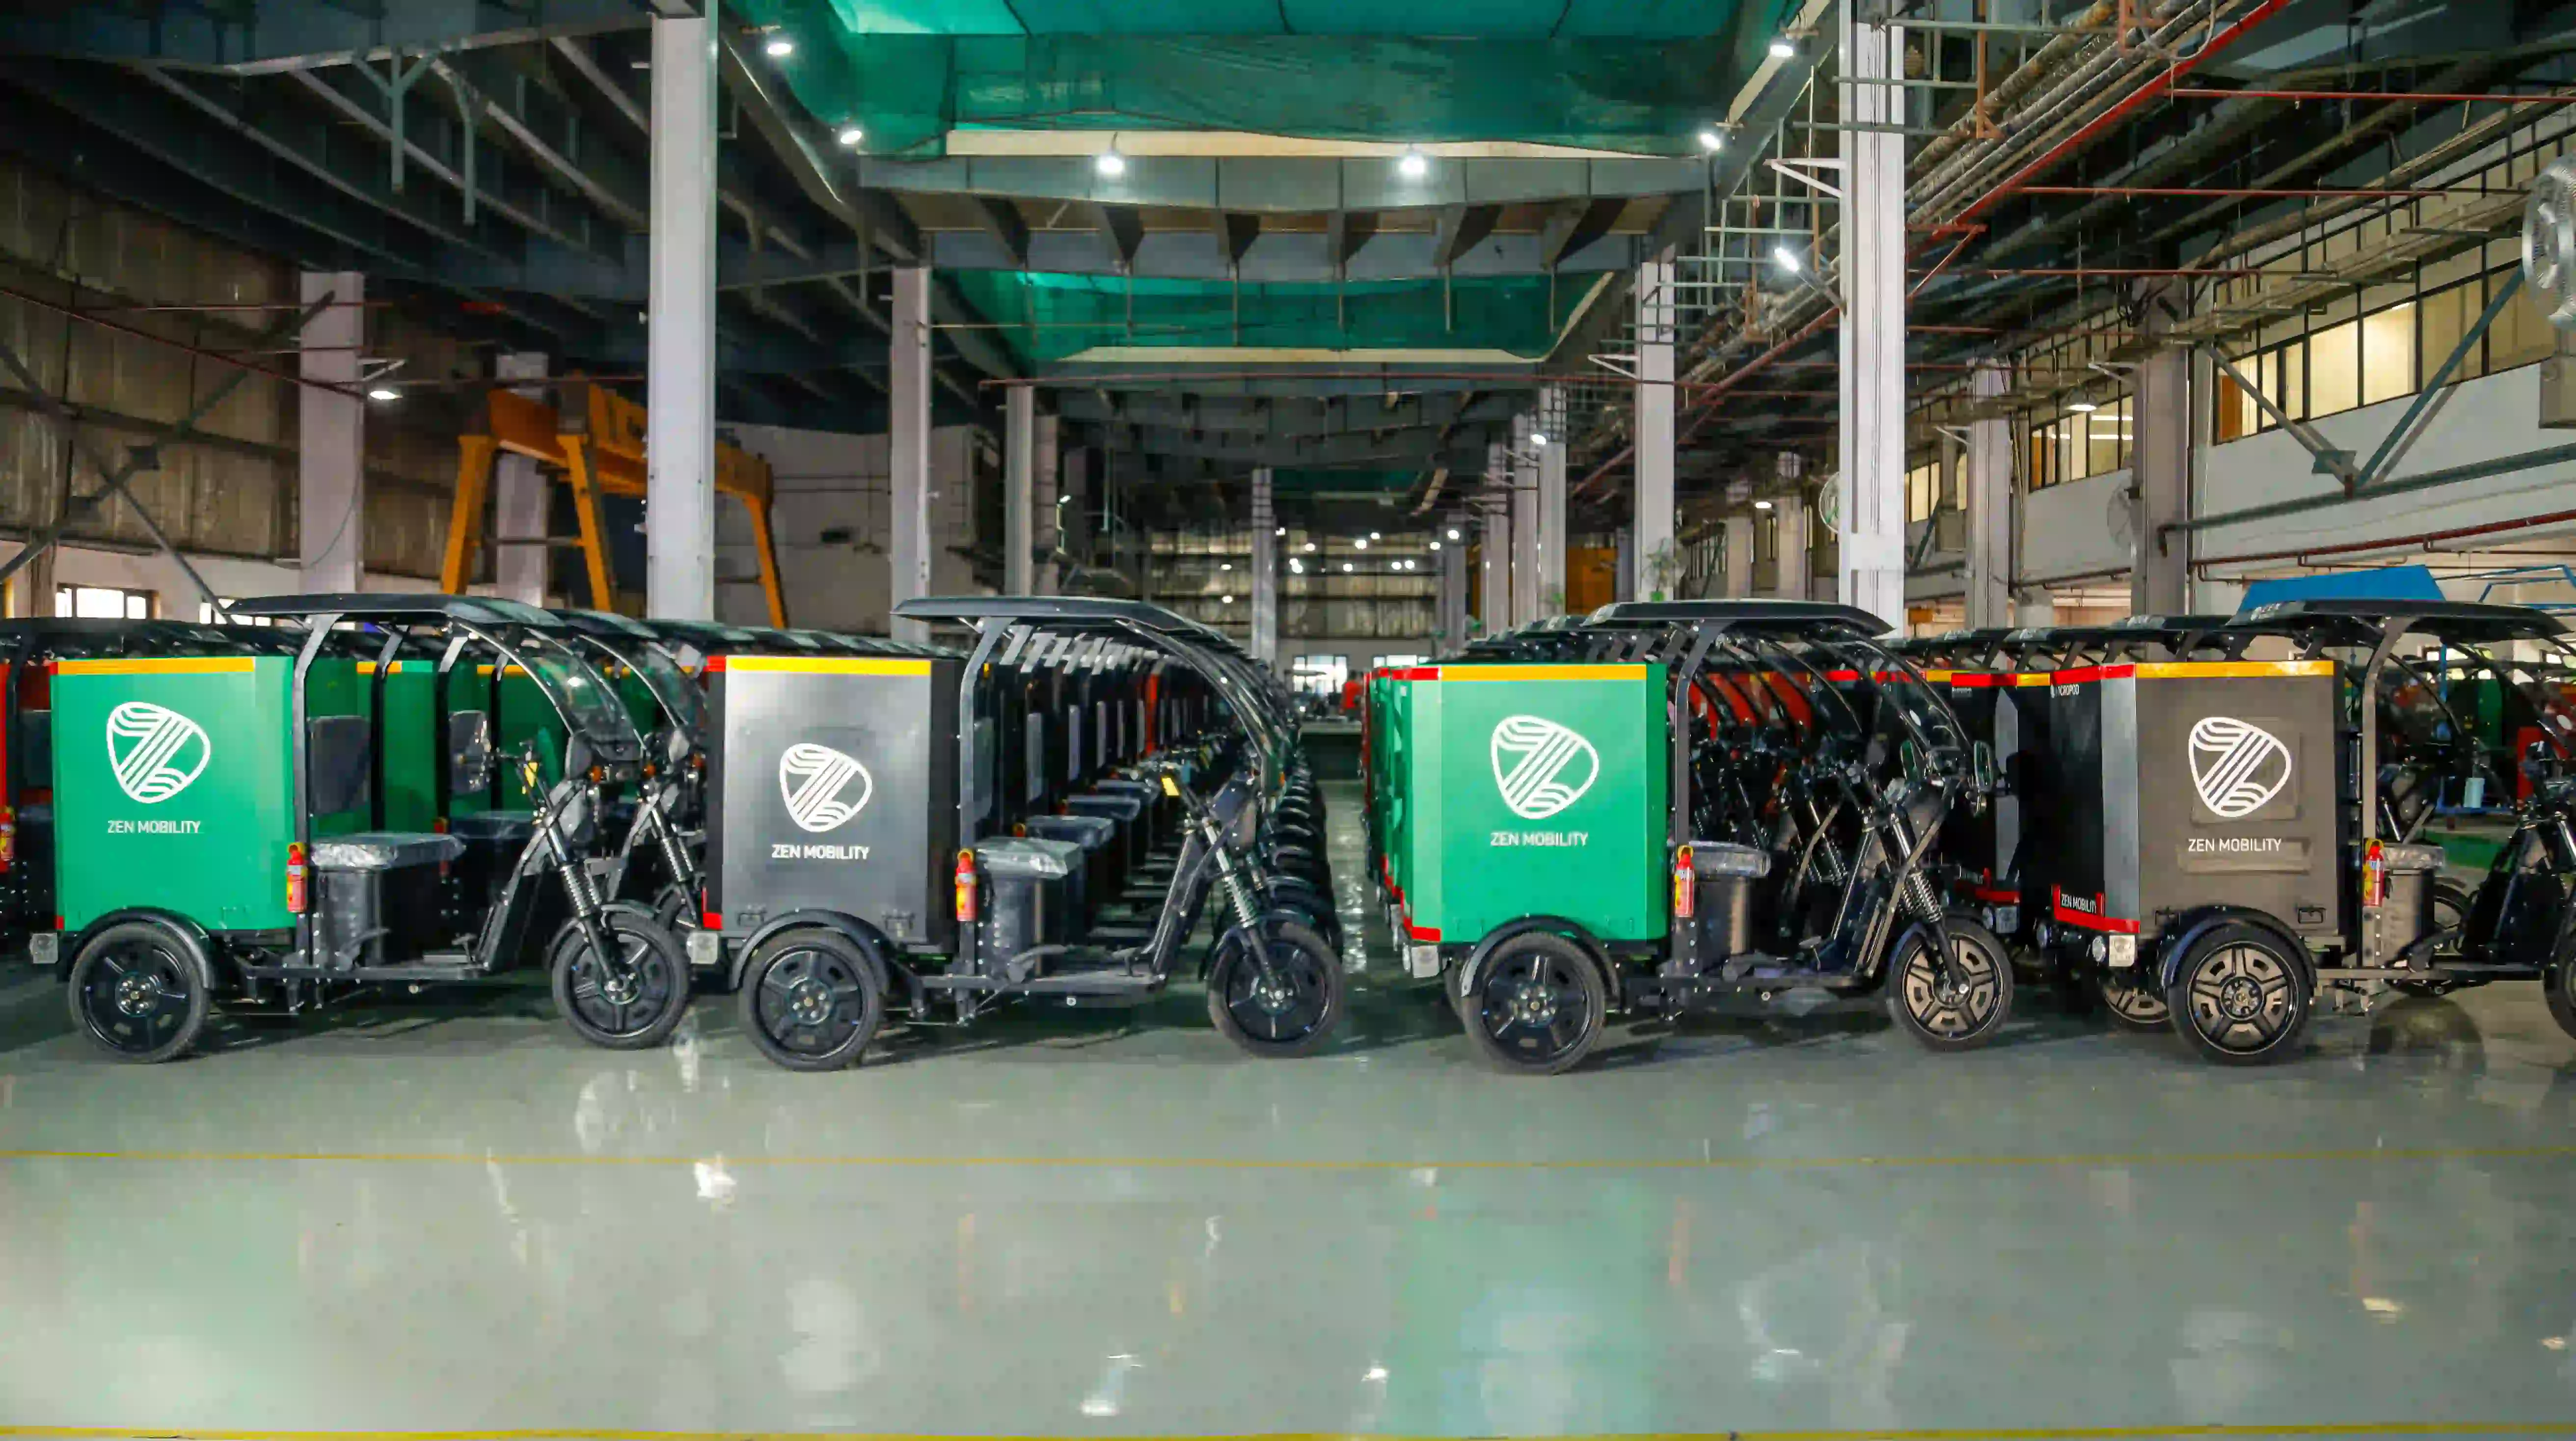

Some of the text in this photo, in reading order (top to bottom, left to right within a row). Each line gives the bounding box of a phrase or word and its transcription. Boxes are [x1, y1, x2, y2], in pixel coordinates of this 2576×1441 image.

[108, 820, 201, 834] ZEN MOBILITY
[1491, 832, 1588, 846] ZEN MOBILITY
[2188, 838, 2281, 852] ZEN MOBILITY
[771, 844, 870, 860] ZEN MOBILITY
[2061, 894, 2097, 914] ZEN MOBILITY
